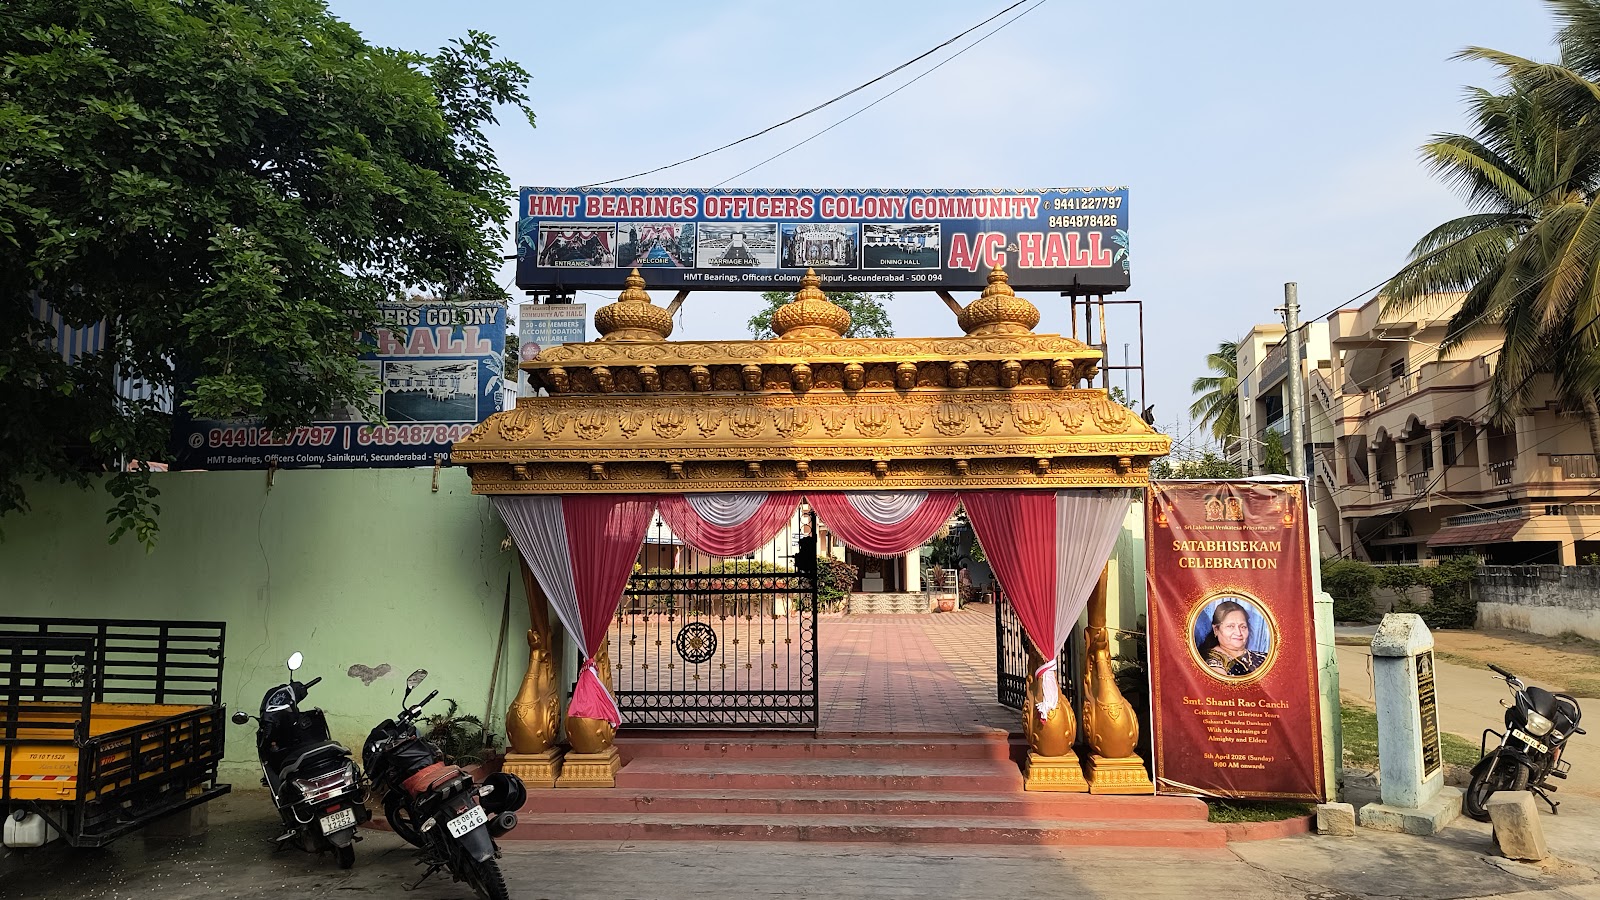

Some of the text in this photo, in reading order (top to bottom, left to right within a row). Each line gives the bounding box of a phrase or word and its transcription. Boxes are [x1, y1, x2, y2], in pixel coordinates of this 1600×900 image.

[528, 195, 1122, 219] HMT BEARINGS OFFICERS COLONY COMMUNITY 9441227797
[1048, 214, 1118, 228] 8464878426
[948, 232, 1112, 272] A/C HALL
[554, 260, 590, 268] ENTRANCE
[636, 257, 669, 265] WELCOME
[683, 273, 702, 281] HMT
[704, 273, 740, 283] Bearings,
[742, 273, 773, 282] Officers
[848, 273, 904, 282] Secunderabad
[911, 274, 927, 282] 500
[928, 274, 943, 282] 094
[427, 307, 498, 326] COLONY
[548, 321, 580, 329] MEMBERS
[522, 328, 583, 336] ACCOMMODATION
[376, 327, 491, 357] HALL
[358, 423, 478, 446] 846487842
[207, 456, 226, 464] HMT
[227, 454, 262, 465] Bearings,
[264, 454, 295, 463] Officers
[296, 453, 325, 464] Colony,
[327, 452, 369, 463] Sainikpuri,
[371, 452, 427, 461] Secunderabad
[433, 452, 449, 461] 500
[1172, 540, 1282, 552] SATABHISEKAM
[1178, 557, 1278, 569] CELEBRATION
[1183, 696, 1289, 709] Smt. Shanti Rao Canchi
[1194, 709, 1227, 717] Celebrating
[1237, 710, 1263, 718] Glorious
[1263, 711, 1280, 719] Years
[1207, 726, 1222, 734] With
[1233, 727, 1260, 736] blessings
[1208, 735, 1234, 743] Almighty
[1248, 736, 1268, 744] Elders
[1215, 753, 1230, 761] April
[1247, 755, 1275, 763] (Sunday)
[1240, 762, 1265, 770] onwards
[455, 815, 484, 835] 1946
